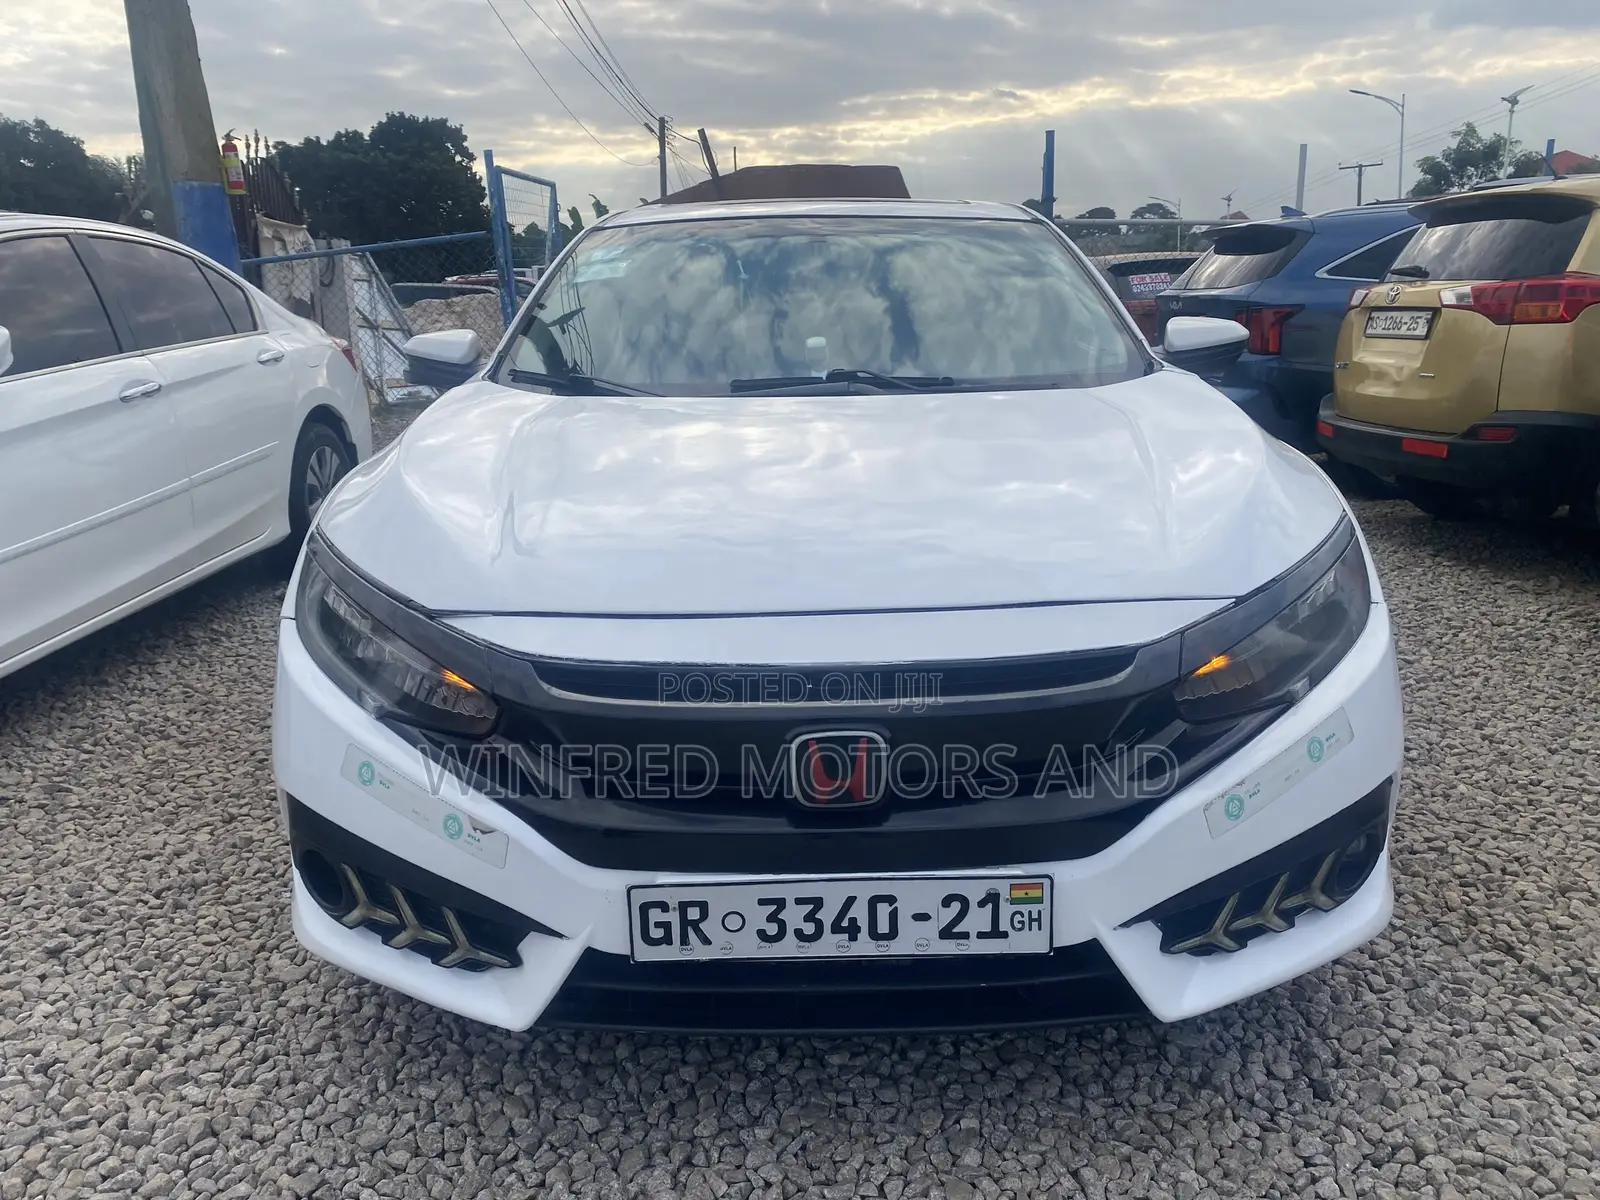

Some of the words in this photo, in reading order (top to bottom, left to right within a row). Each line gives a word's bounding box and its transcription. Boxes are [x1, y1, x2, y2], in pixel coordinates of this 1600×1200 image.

[1131, 275, 1147, 283] FOR
[1149, 273, 1169, 282] SALE
[639, 900, 713, 946] GR
[756, 893, 1010, 943] 3340-21
[1009, 909, 1042, 932] GH
